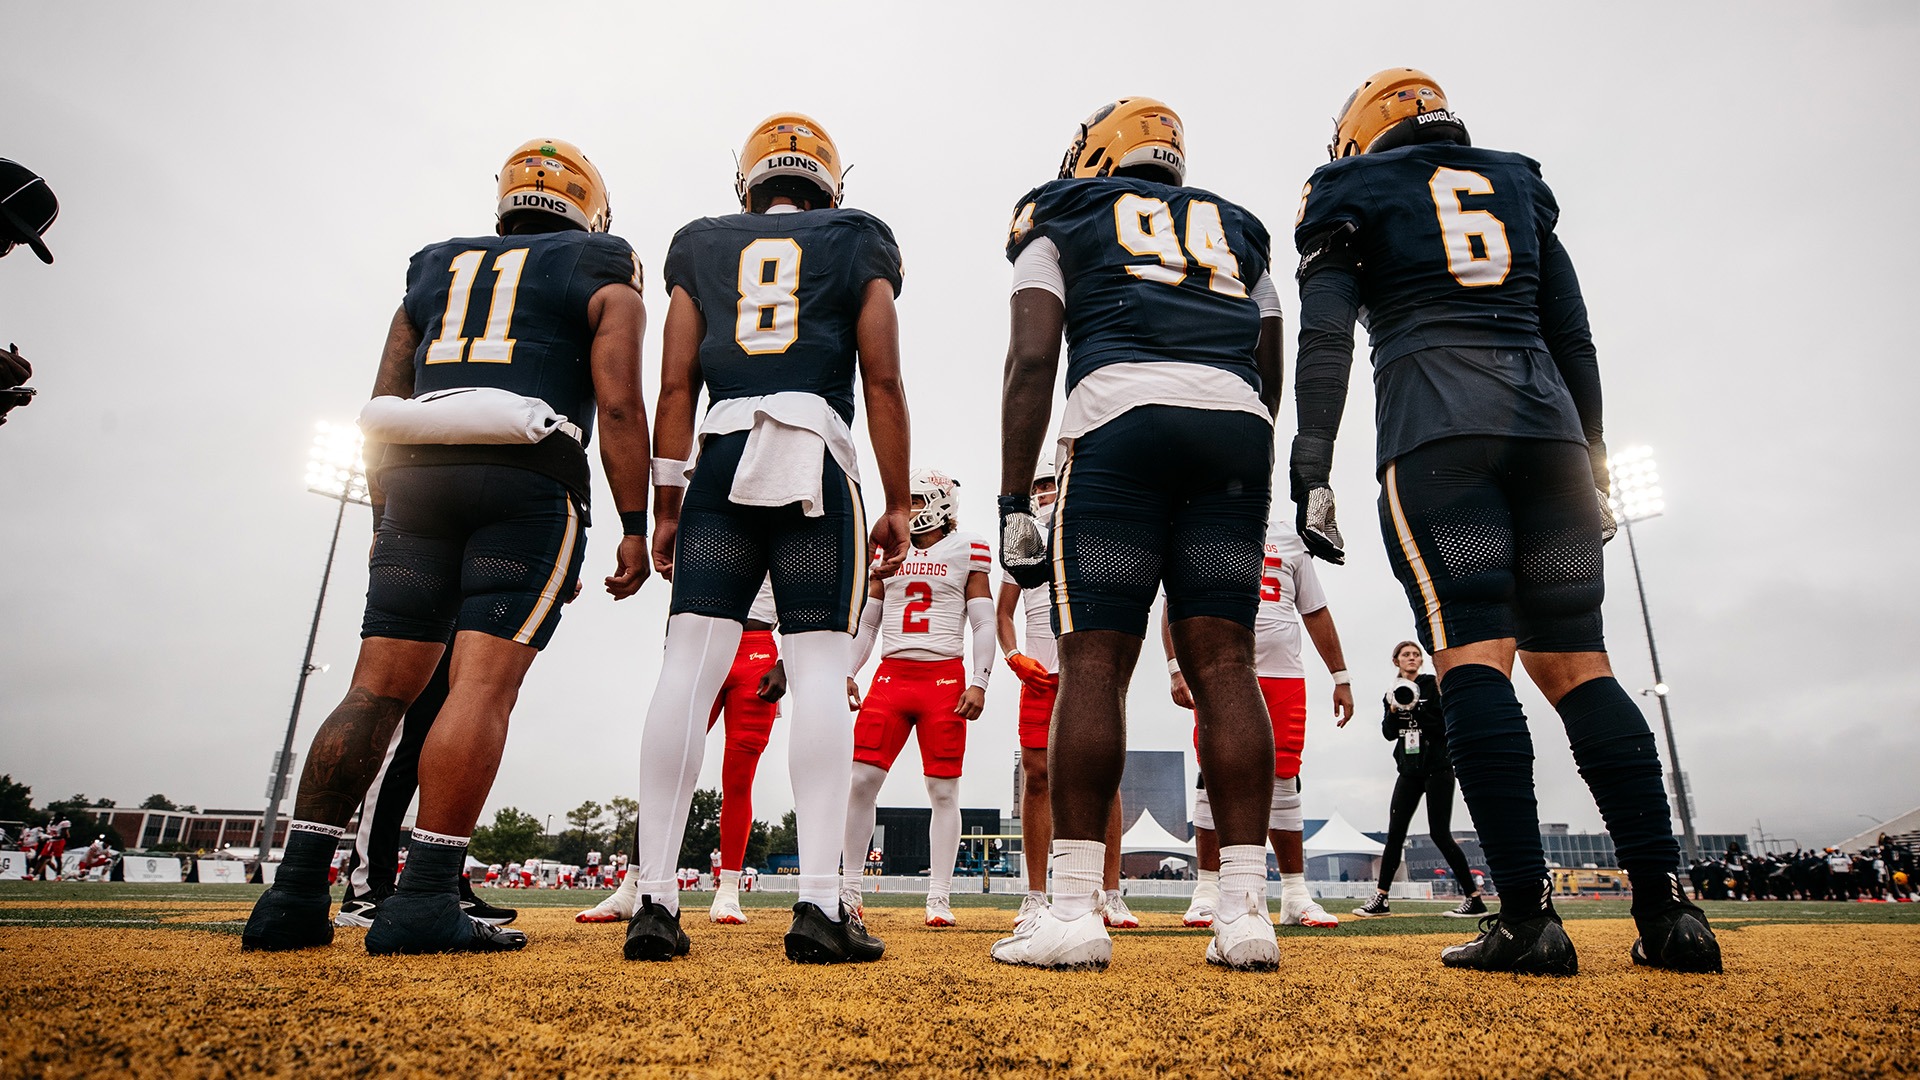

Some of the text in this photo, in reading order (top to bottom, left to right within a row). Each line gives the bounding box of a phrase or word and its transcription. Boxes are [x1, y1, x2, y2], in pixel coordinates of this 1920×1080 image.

[767, 156, 818, 173] LIONS
[513, 195, 567, 214] LIONS
[1428, 166, 1512, 287] 6
[1113, 193, 1249, 298] 94
[425, 248, 530, 365] 11
[735, 238, 803, 356] 8
[894, 562, 948, 577] AQUEROS
[902, 581, 932, 634] 2
[869, 851, 882, 861] 25
